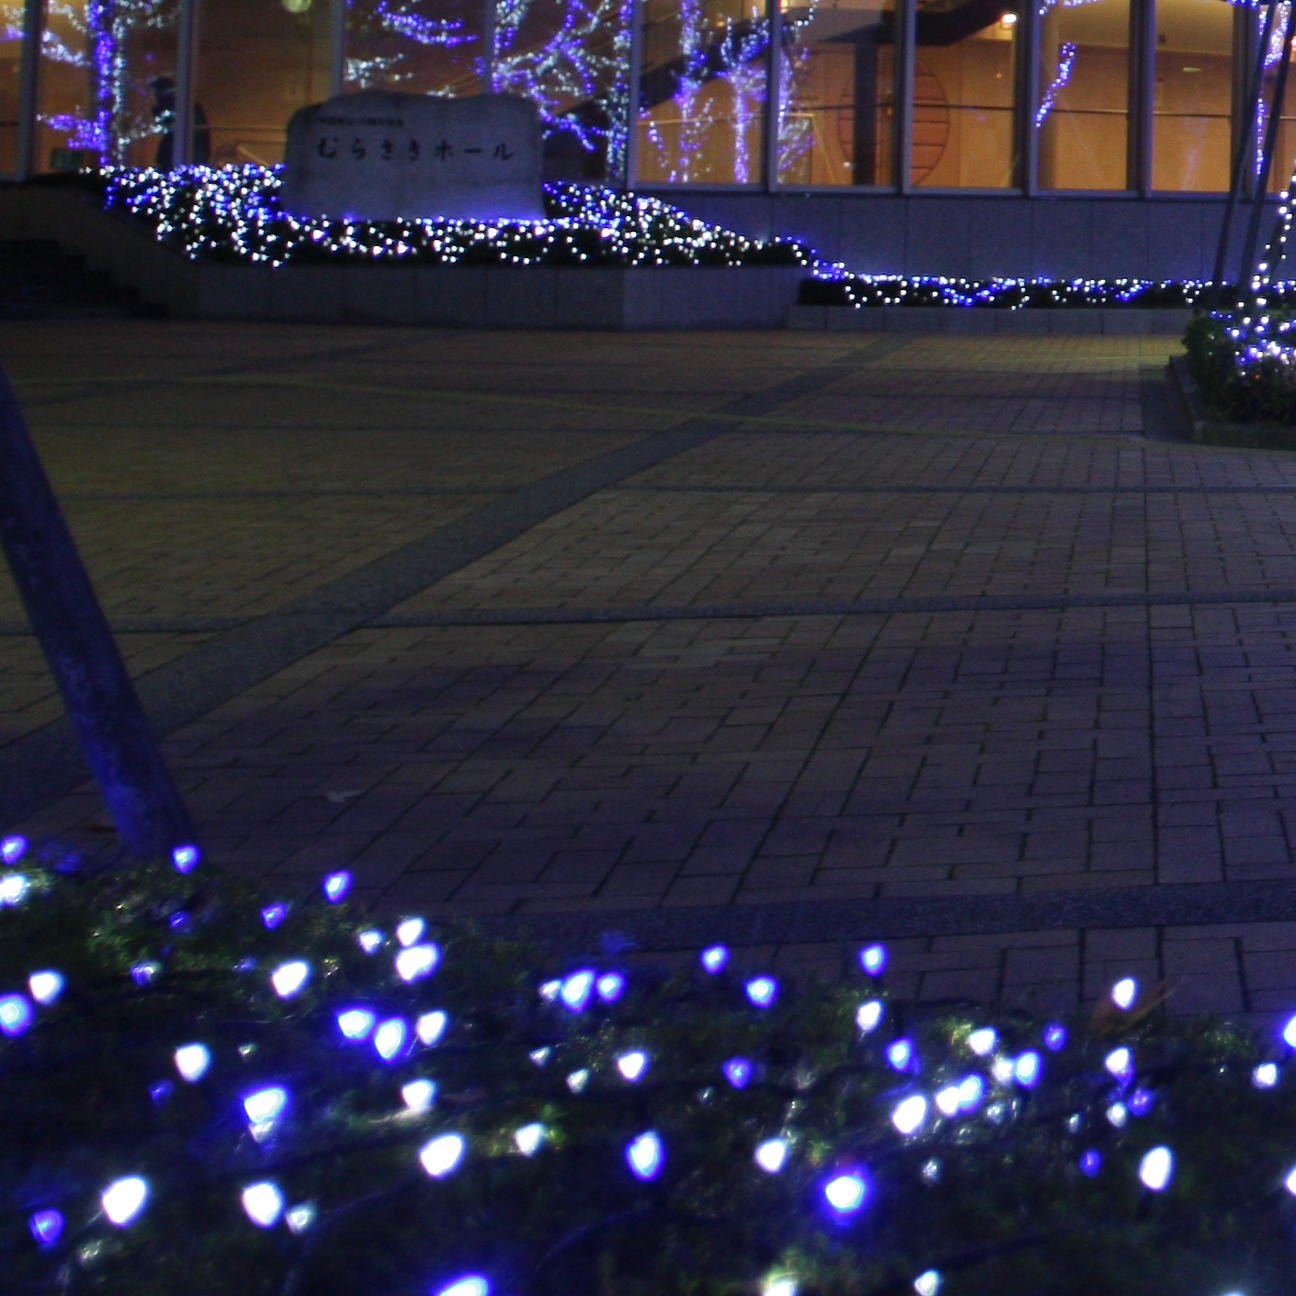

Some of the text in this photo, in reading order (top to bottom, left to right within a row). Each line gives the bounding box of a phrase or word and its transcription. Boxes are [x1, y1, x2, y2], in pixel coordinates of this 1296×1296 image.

[316, 137, 515, 162] むらさきホール
